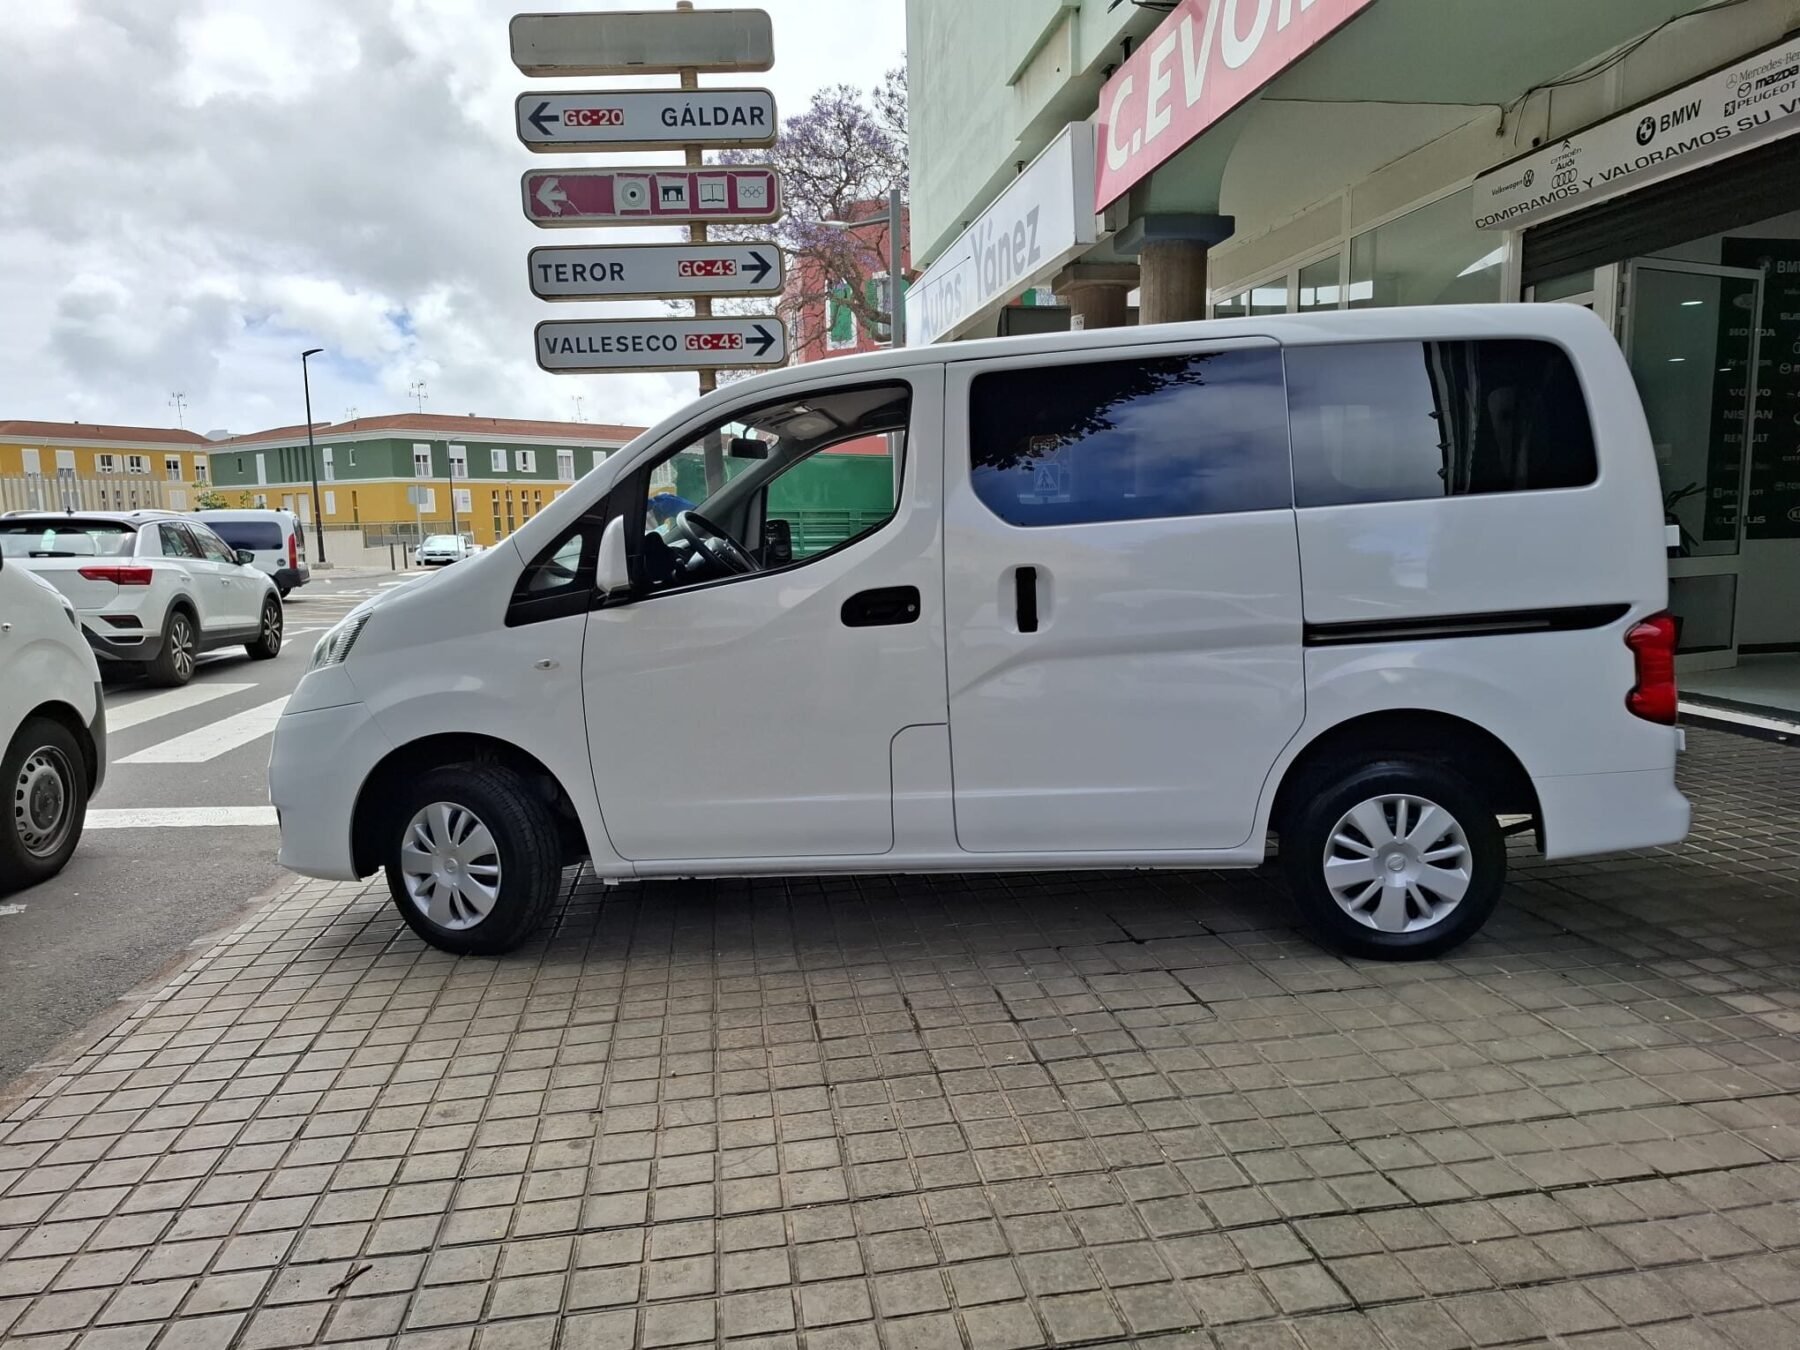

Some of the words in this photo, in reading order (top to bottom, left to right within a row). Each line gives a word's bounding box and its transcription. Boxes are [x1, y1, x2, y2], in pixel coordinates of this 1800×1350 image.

[1737, 79, 1799, 109] PEUGEOT
[564, 109, 624, 126] GC-20
[661, 102, 765, 127] GÁLDAR
[1660, 99, 1701, 133] BMW
[1475, 183, 1580, 228] COMPRAMOS
[1582, 176, 1593, 188] Y
[1599, 125, 1731, 181] VALORAMOS
[1736, 110, 1771, 132] SU
[1555, 158, 1575, 172] Audi
[538, 262, 625, 283] TEROR
[678, 260, 737, 277] GC-43
[920, 272, 962, 343] Autos
[970, 204, 1041, 301] Yánez
[545, 334, 677, 354] VALLESECO
[685, 333, 742, 350] GC-43
[1728, 327, 1776, 337] HODA
[1729, 388, 1772, 398] VOVO
[1723, 408, 1774, 420] NISAN
